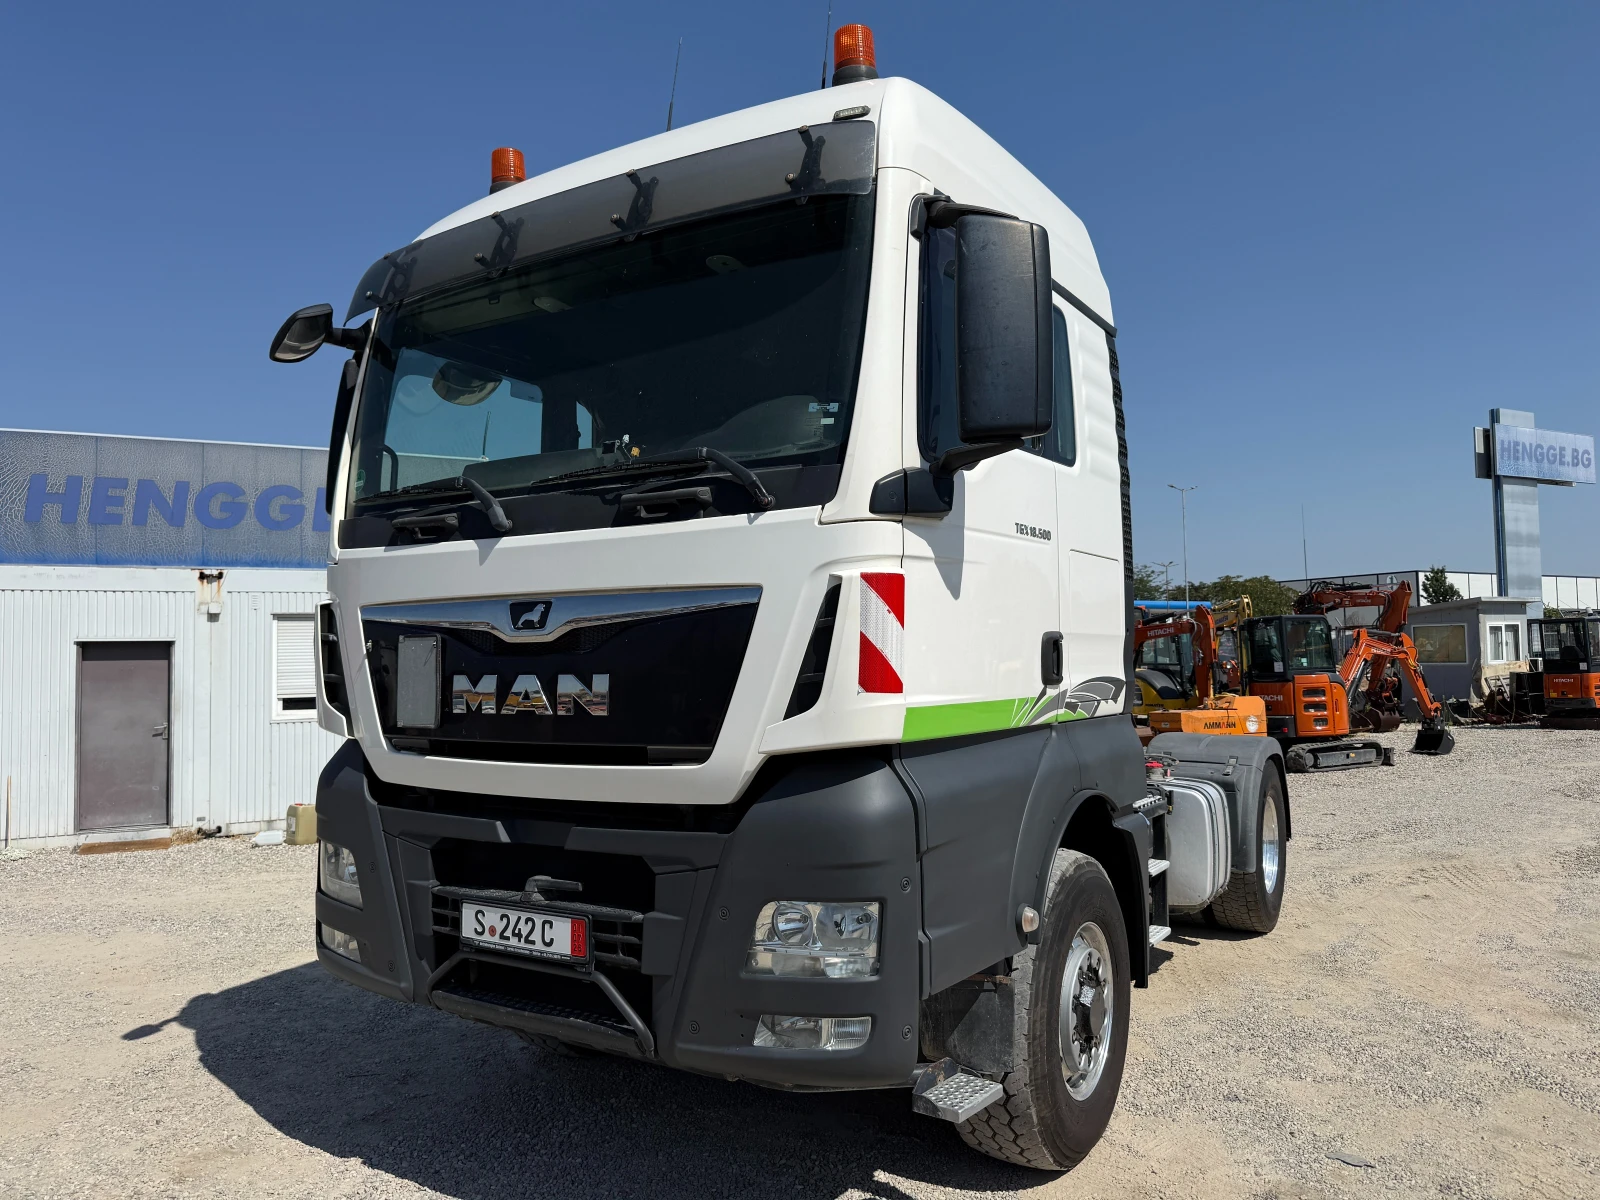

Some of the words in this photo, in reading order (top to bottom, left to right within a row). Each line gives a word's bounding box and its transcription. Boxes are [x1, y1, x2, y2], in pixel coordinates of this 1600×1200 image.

[1500, 440, 1592, 469] HENGGE.BG
[1014, 522, 1029, 536] TGX
[1029, 526, 1051, 541] 18.500
[1147, 627, 1174, 637] HITACHI
[452, 674, 610, 716] MAN
[1259, 694, 1284, 702] TACHI
[1203, 721, 1236, 730] AMMANN
[474, 909, 486, 936] S
[499, 913, 536, 946] 242
[541, 919, 554, 948] C
